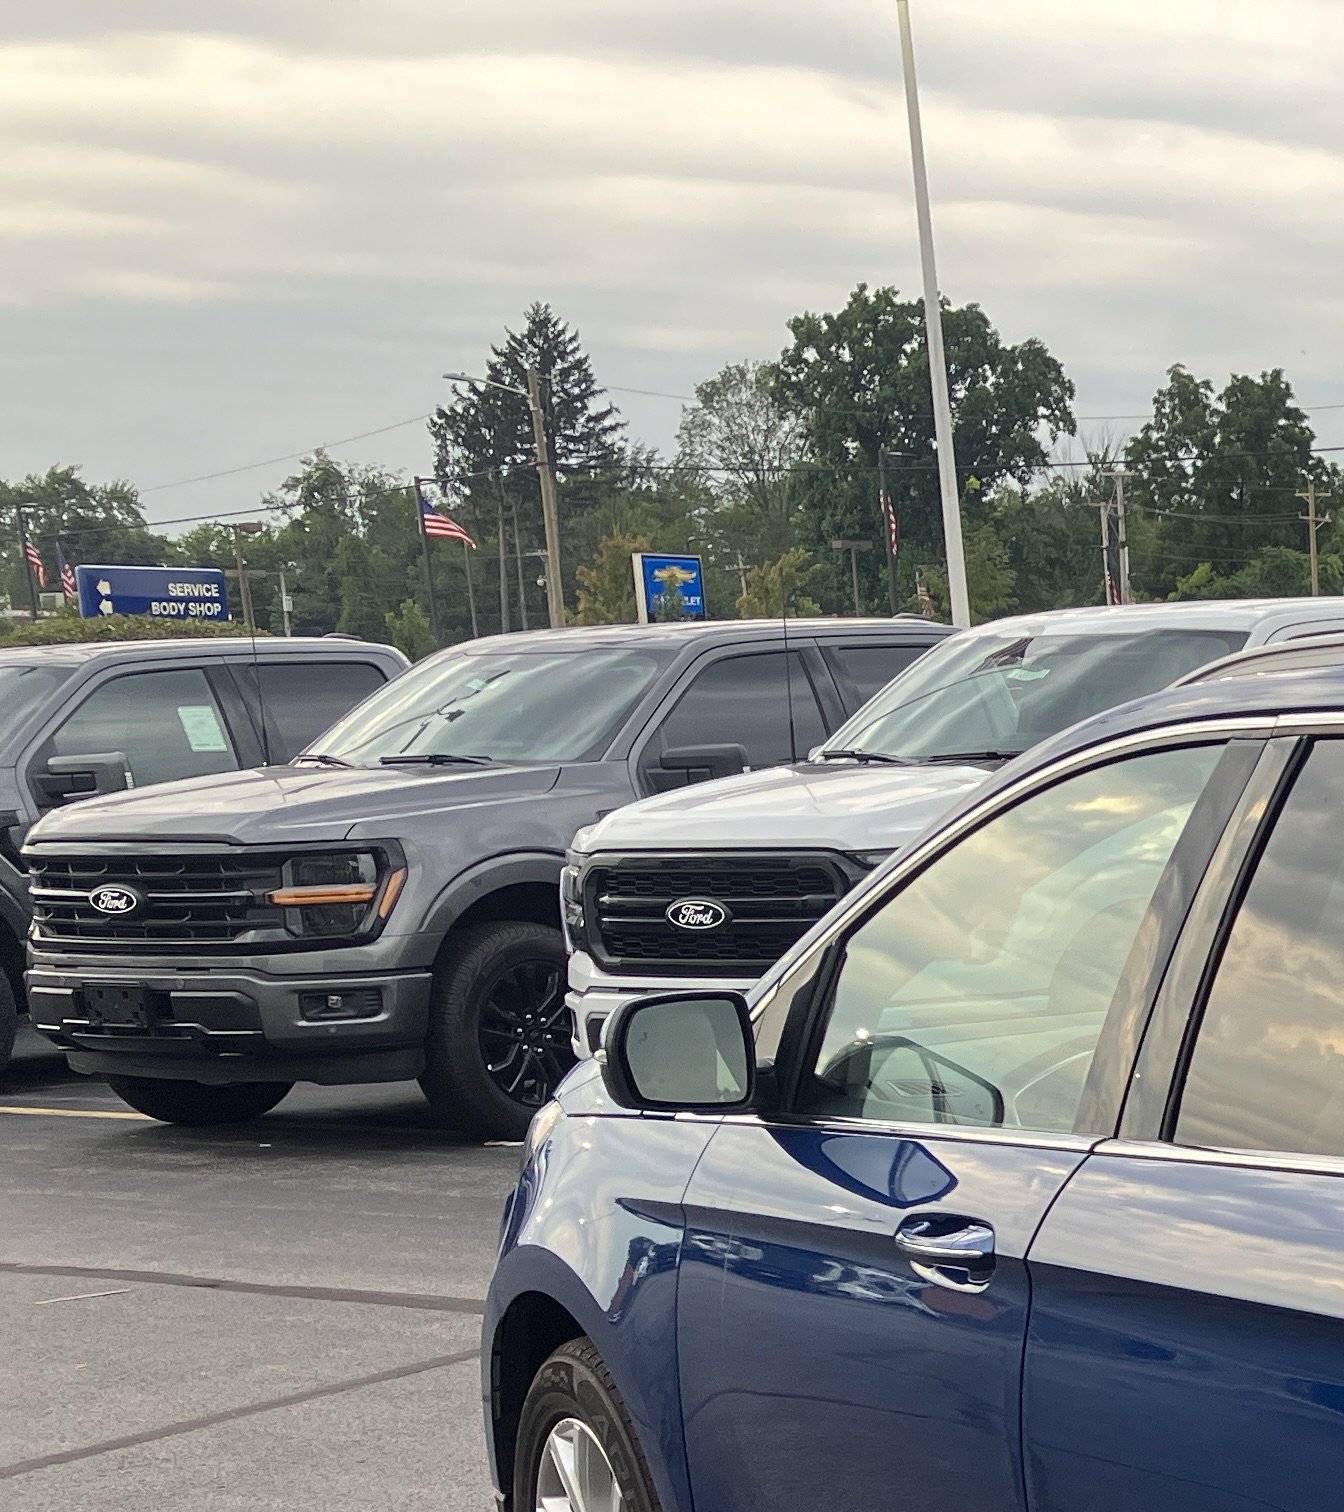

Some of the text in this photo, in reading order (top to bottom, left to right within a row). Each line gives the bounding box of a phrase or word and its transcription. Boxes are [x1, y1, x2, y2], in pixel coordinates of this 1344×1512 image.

[168, 582, 219, 597] SERVICE
[151, 601, 222, 616] BODY SHOP
[678, 904, 714, 925] Ford
